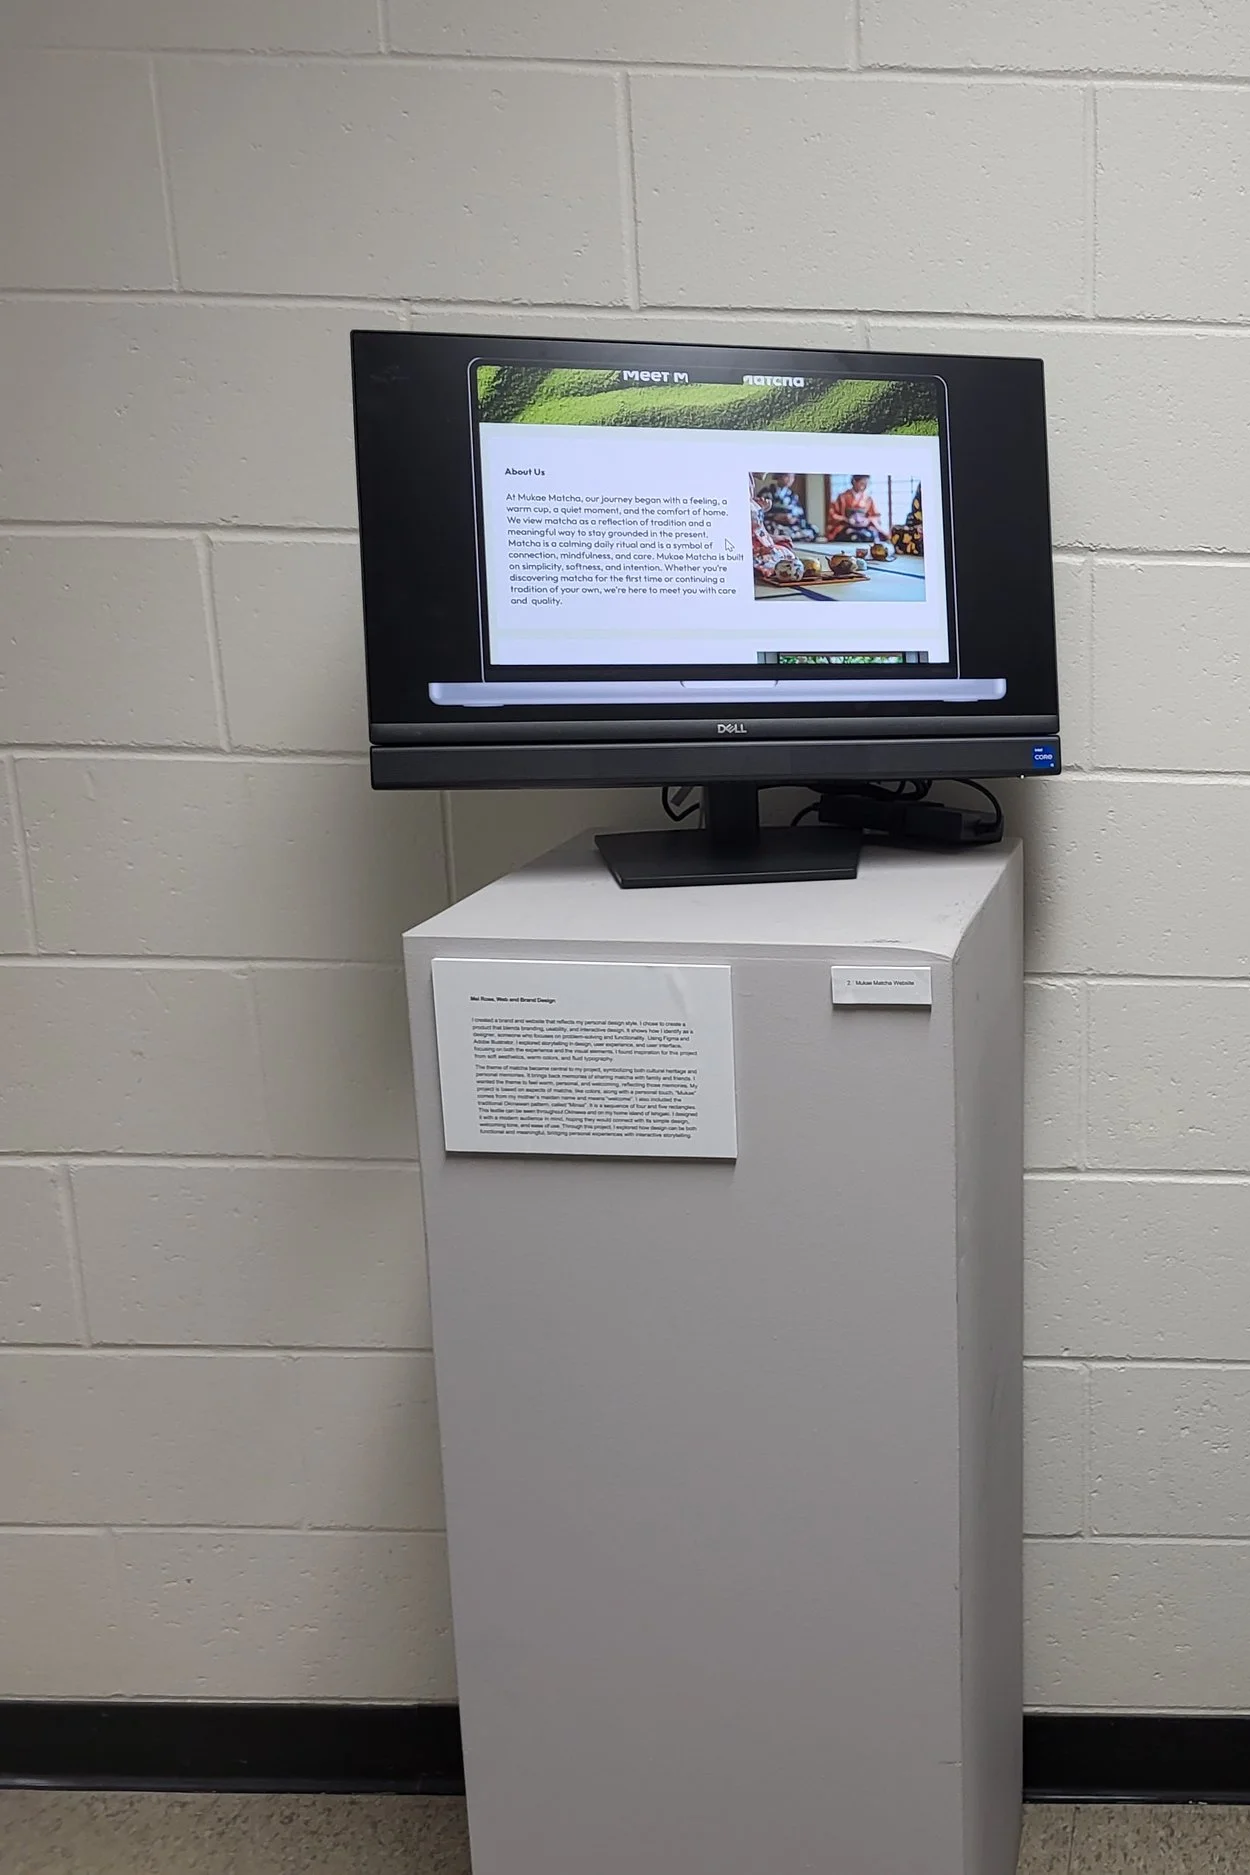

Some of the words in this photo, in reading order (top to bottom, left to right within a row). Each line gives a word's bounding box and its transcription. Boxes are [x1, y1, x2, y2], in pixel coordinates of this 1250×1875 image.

[504, 467, 532, 476] About
[517, 493, 546, 501] Mukae
[548, 494, 583, 503] Matcha,
[600, 495, 633, 505] journey
[634, 495, 661, 505] began
[689, 496, 720, 506] feeling,
[560, 506, 581, 515] quiet
[583, 507, 621, 515] moment,
[656, 507, 690, 515] comfort
[702, 508, 728, 516] home.
[506, 516, 521, 524] We
[544, 517, 577, 525] matcha
[598, 518, 638, 526] reflection
[639, 518, 649, 526] of
[507, 528, 556, 538] meaningful
[588, 529, 606, 538] stay
[607, 529, 648, 538] grounded
[508, 539, 541, 547] Matcha
[542, 539, 549, 547] is
[558, 540, 592, 550] calming
[593, 540, 614, 550] daily
[616, 540, 638, 548] ritual
[673, 541, 702, 550] symbol
[508, 551, 558, 560] connection,
[560, 551, 613, 560] mindfulness,
[522, 562, 564, 572] simplicity,
[565, 562, 603, 572] softness,
[623, 563, 662, 571] intention.
[664, 563, 700, 572] Whether
[509, 573, 558, 584] discovering
[594, 574, 608, 582] for
[625, 574, 641, 582] first
[675, 575, 717, 585] continuing
[510, 585, 548, 593] tradition
[510, 596, 527, 604] and
[531, 596, 562, 606] quality.
[717, 724, 747, 733] DELL
